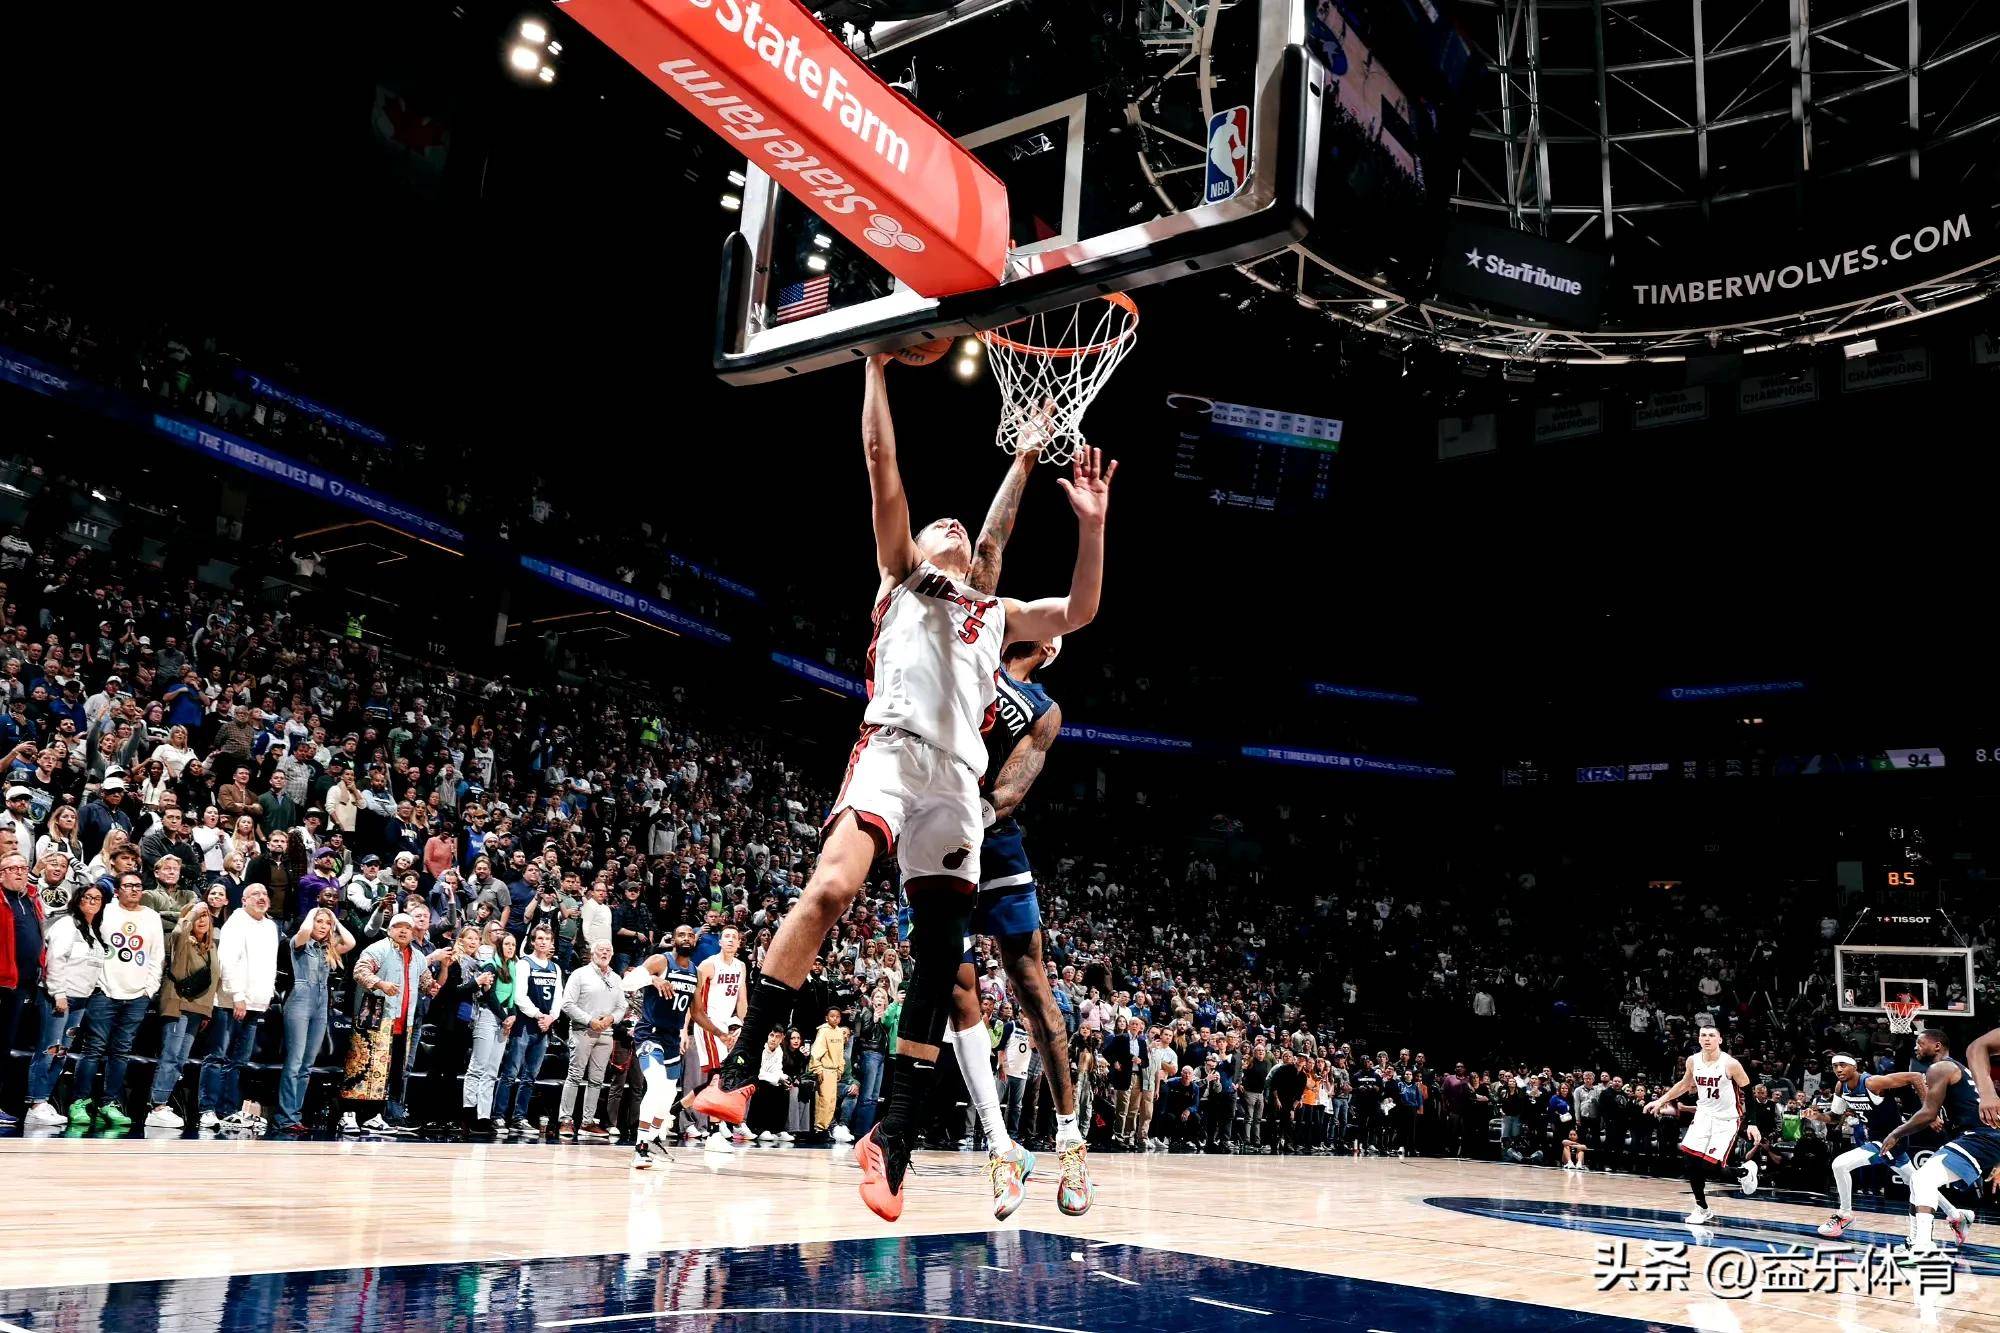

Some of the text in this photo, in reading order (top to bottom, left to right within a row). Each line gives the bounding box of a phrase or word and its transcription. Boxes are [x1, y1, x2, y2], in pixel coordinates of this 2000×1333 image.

[1210, 180, 1230, 199] NBA
[1633, 213, 1972, 305] TIMBERWOLVES.COM
[1484, 254, 1582, 296] StarTribune
[1848, 361, 1924, 382] CHAMPIONS
[198, 430, 222, 451] THE
[223, 440, 307, 484] TIMBERWOLVES
[308, 473, 325, 491] ON
[75, 520, 98, 538] 111
[958, 616, 985, 644] 5
[428, 641, 446, 656] 112
[1268, 748, 1284, 760] THE
[1284, 750, 1338, 766] TIMBERWOLVES
[1908, 753, 1931, 767] 94
[1888, 871, 1915, 886] 8.5
[1893, 916, 1931, 924] TISSOT
[717, 971, 741, 985] HEAT
[542, 986, 552, 1000] 5
[725, 984, 738, 997] 55
[672, 993, 689, 1012] 10
[1018, 1043, 1027, 1054] 0
[1695, 1075, 1722, 1088] HEAT
[1707, 1087, 1720, 1100] 14
